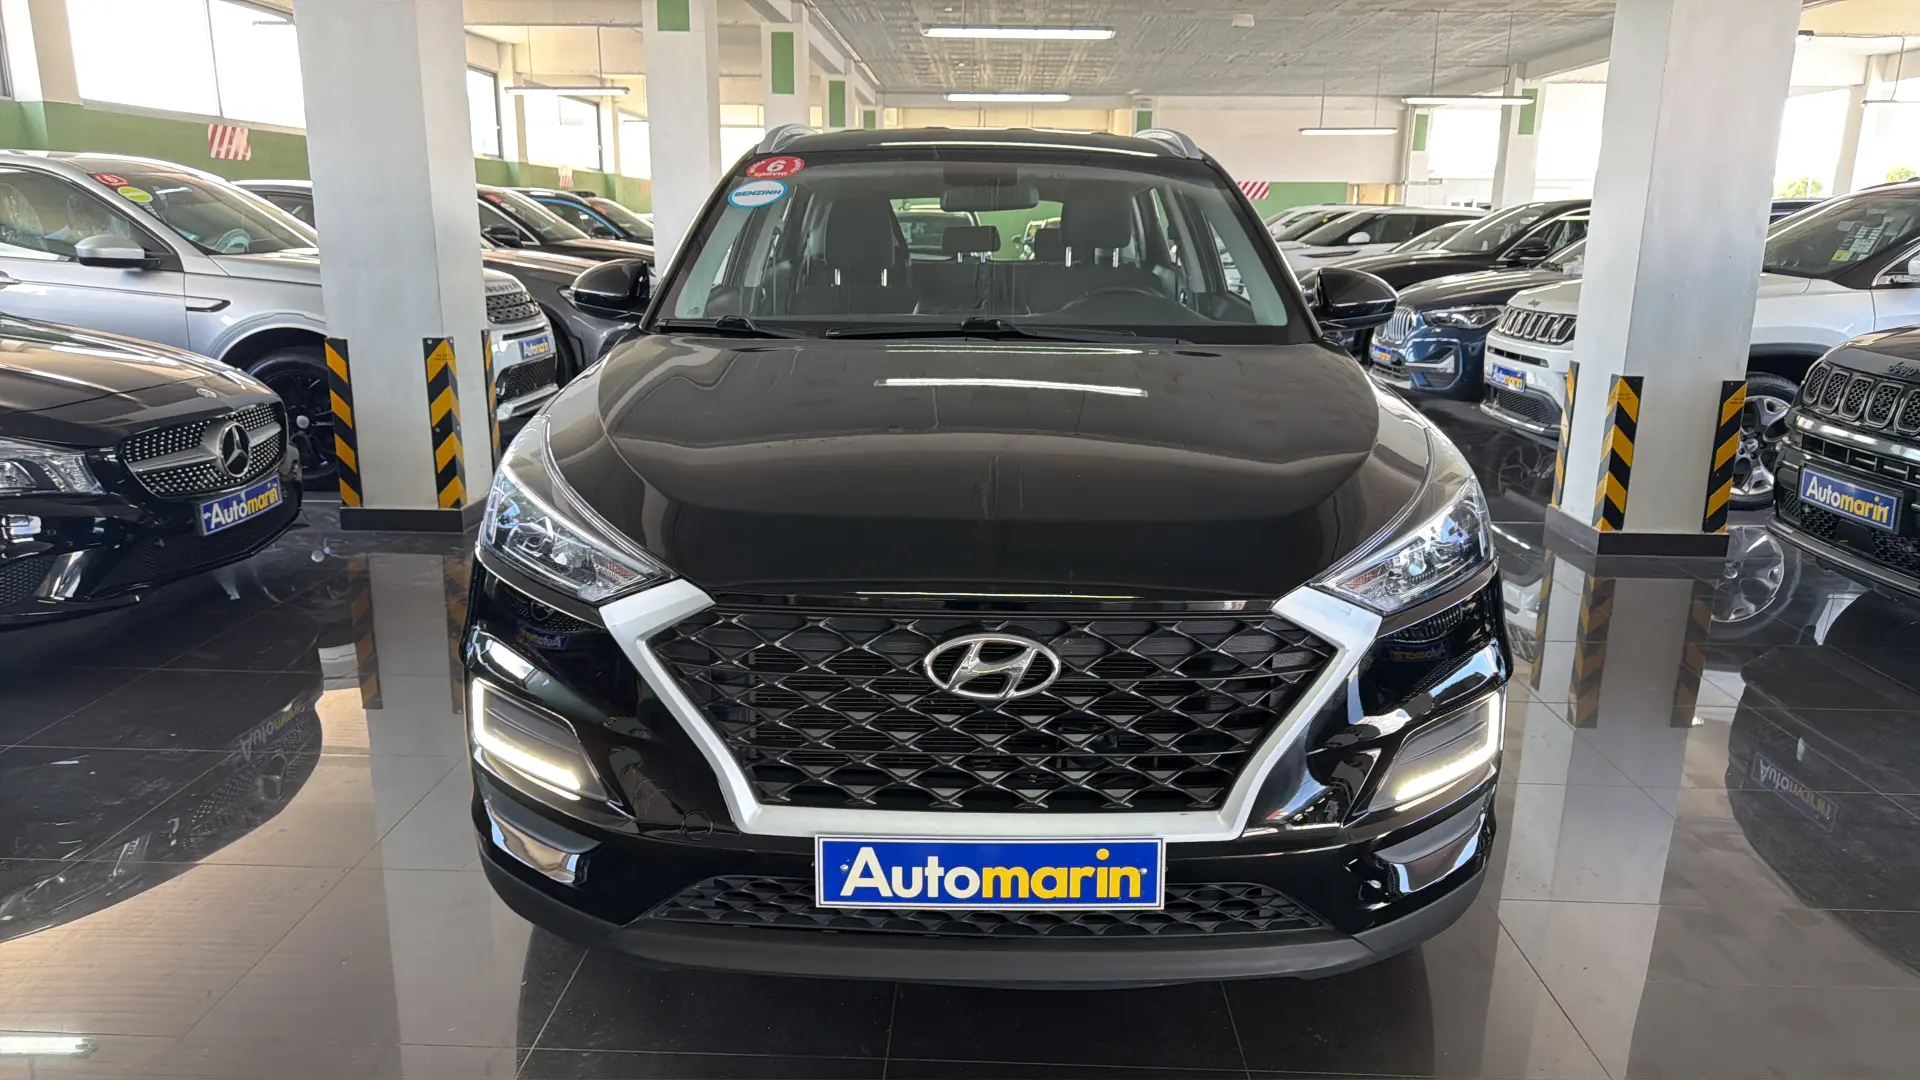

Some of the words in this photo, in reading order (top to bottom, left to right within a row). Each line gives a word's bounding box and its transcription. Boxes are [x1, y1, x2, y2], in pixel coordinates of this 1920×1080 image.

[767, 159, 787, 172] 6
[210, 482, 279, 529] Automarin
[1806, 475, 1890, 524] Automarin
[840, 847, 1141, 899] Automarin
